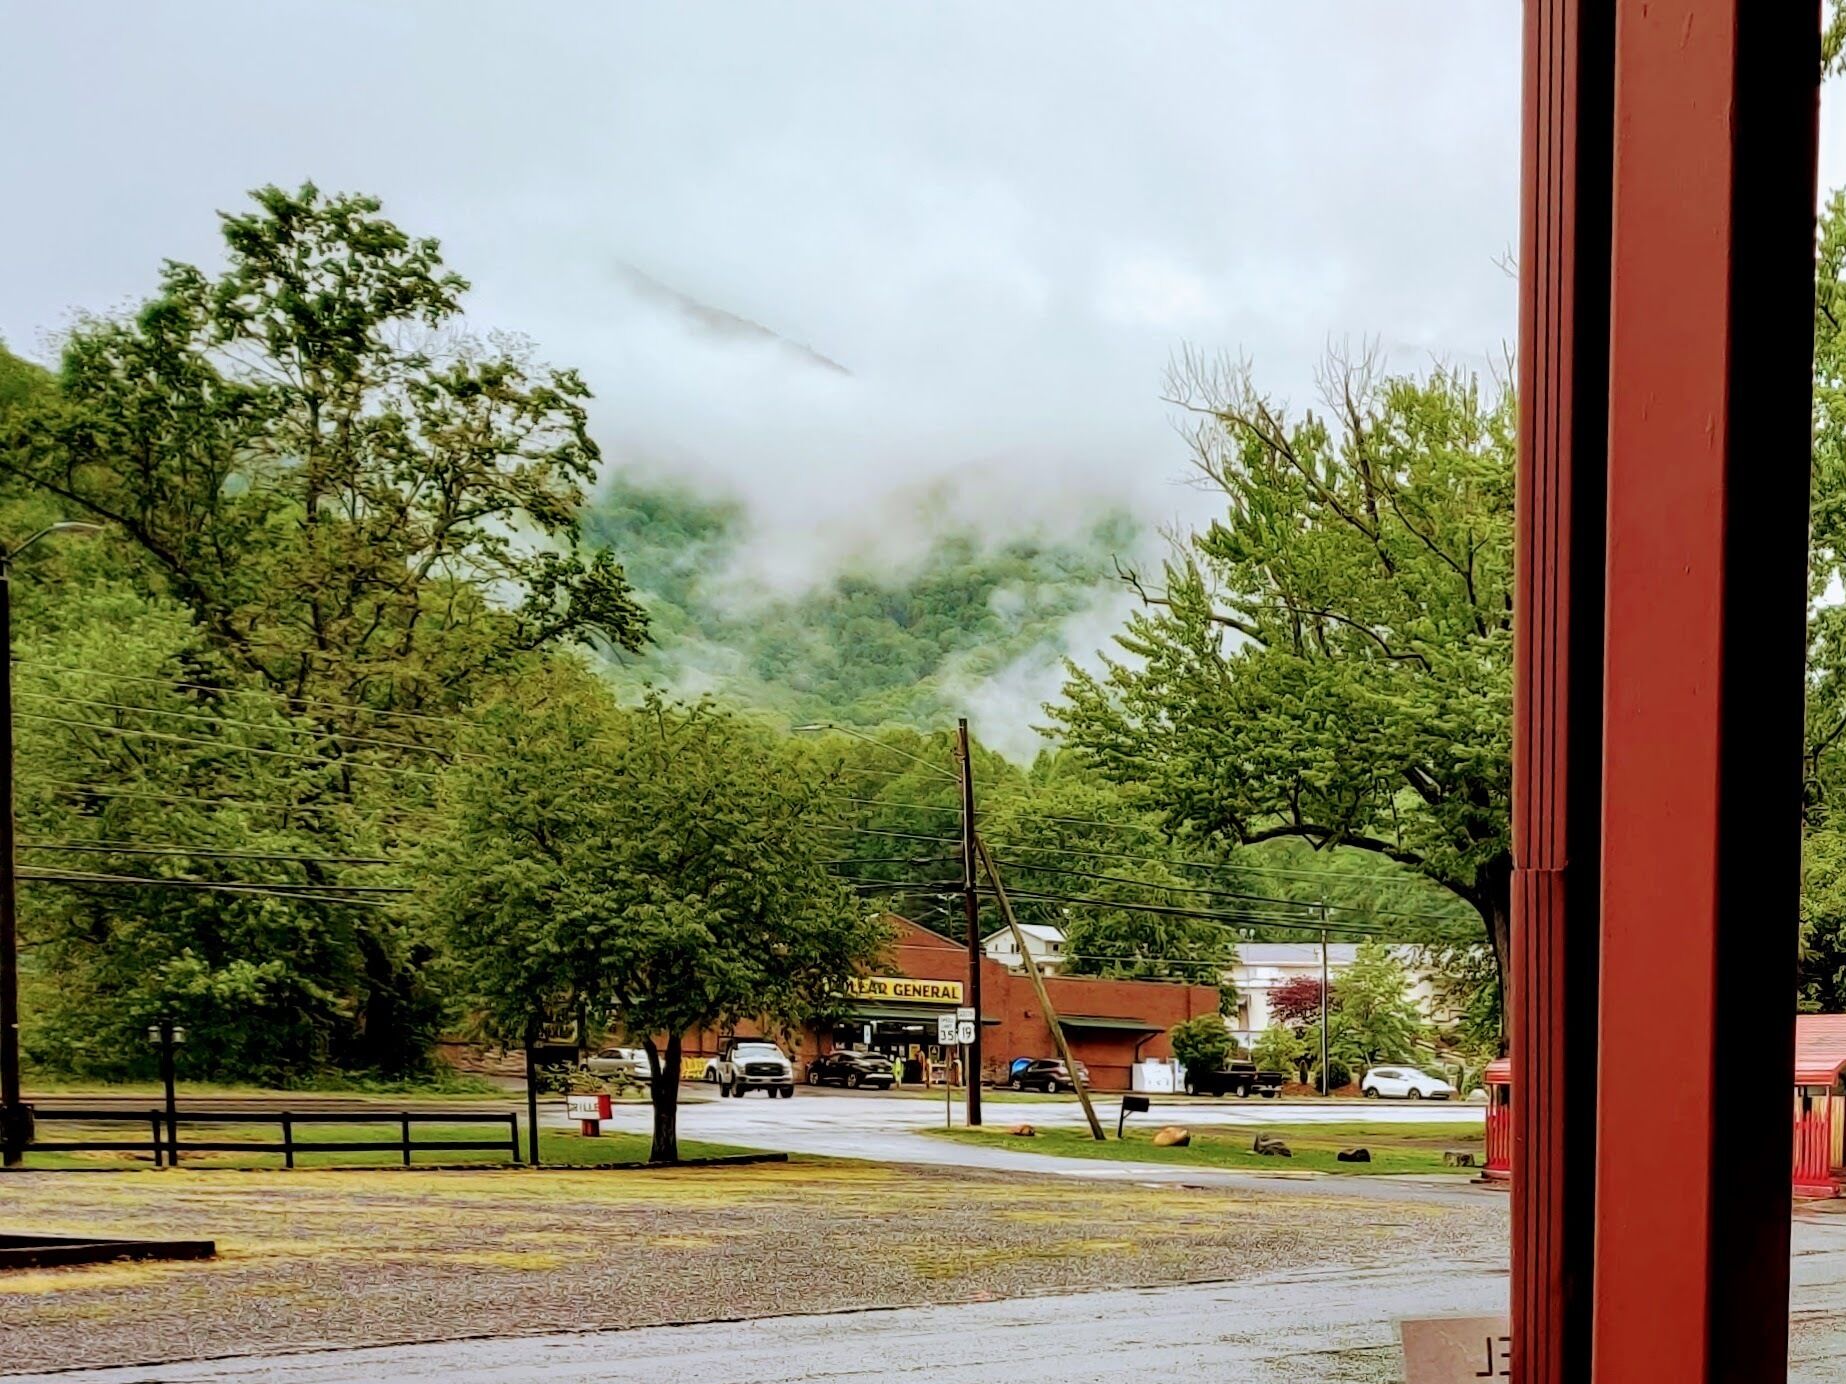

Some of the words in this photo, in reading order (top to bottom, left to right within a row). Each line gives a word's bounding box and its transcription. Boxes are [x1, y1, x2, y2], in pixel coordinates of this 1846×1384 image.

[893, 983, 961, 1000] GENERAL
[940, 1030, 954, 1041] 35
[962, 1026, 972, 1039] 19
